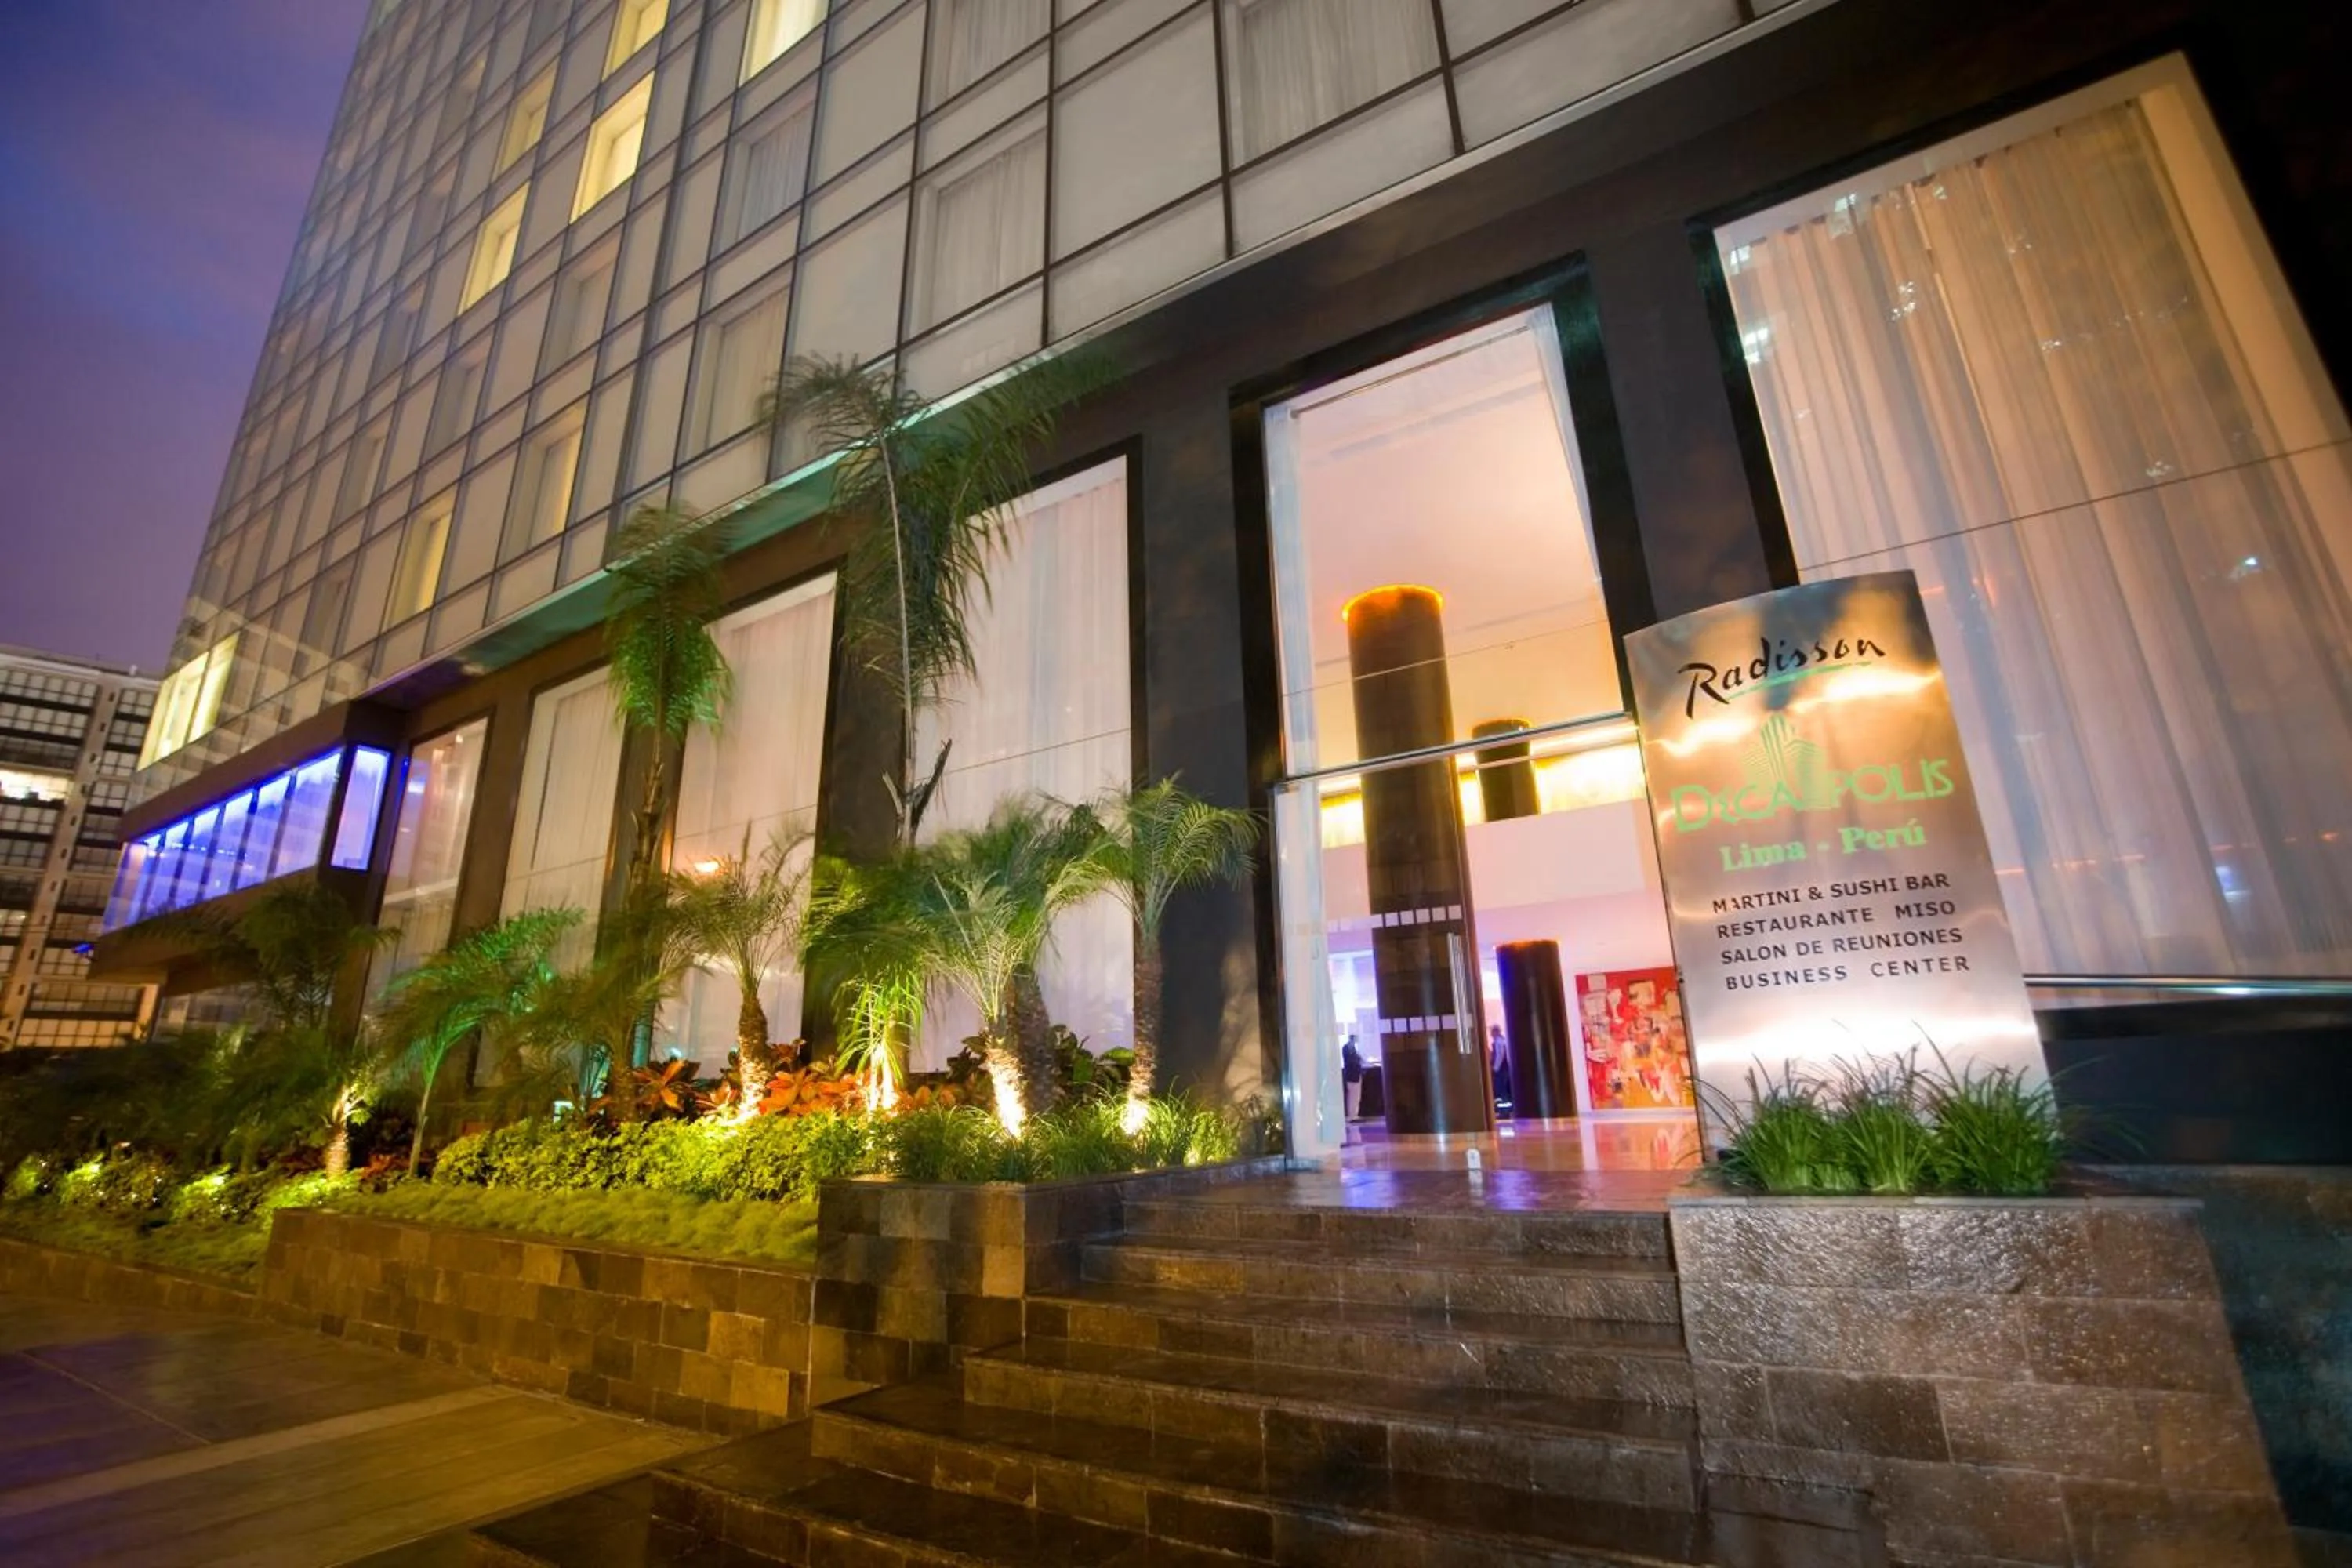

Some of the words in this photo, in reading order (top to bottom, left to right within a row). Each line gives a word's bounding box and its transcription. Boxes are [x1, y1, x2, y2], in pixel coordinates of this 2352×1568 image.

[1677, 637, 1886, 719] Radisson
[1719, 843, 1806, 871] Lima
[1838, 818, 1926, 853] Perú
[1713, 889, 1801, 913] MARTINI
[1808, 887, 1823, 901] &
[1831, 877, 1898, 898] SUSHI
[1905, 873, 1951, 891] BAR
[1717, 908, 1874, 938] RESTAURANTE
[1895, 901, 1955, 920] MISO
[1721, 945, 1787, 965] SALON
[1797, 941, 1823, 955] DE
[1833, 928, 1962, 953] REUNIONES
[1726, 966, 1847, 990] BUSINESS
[1871, 956, 1970, 977] CENTER
